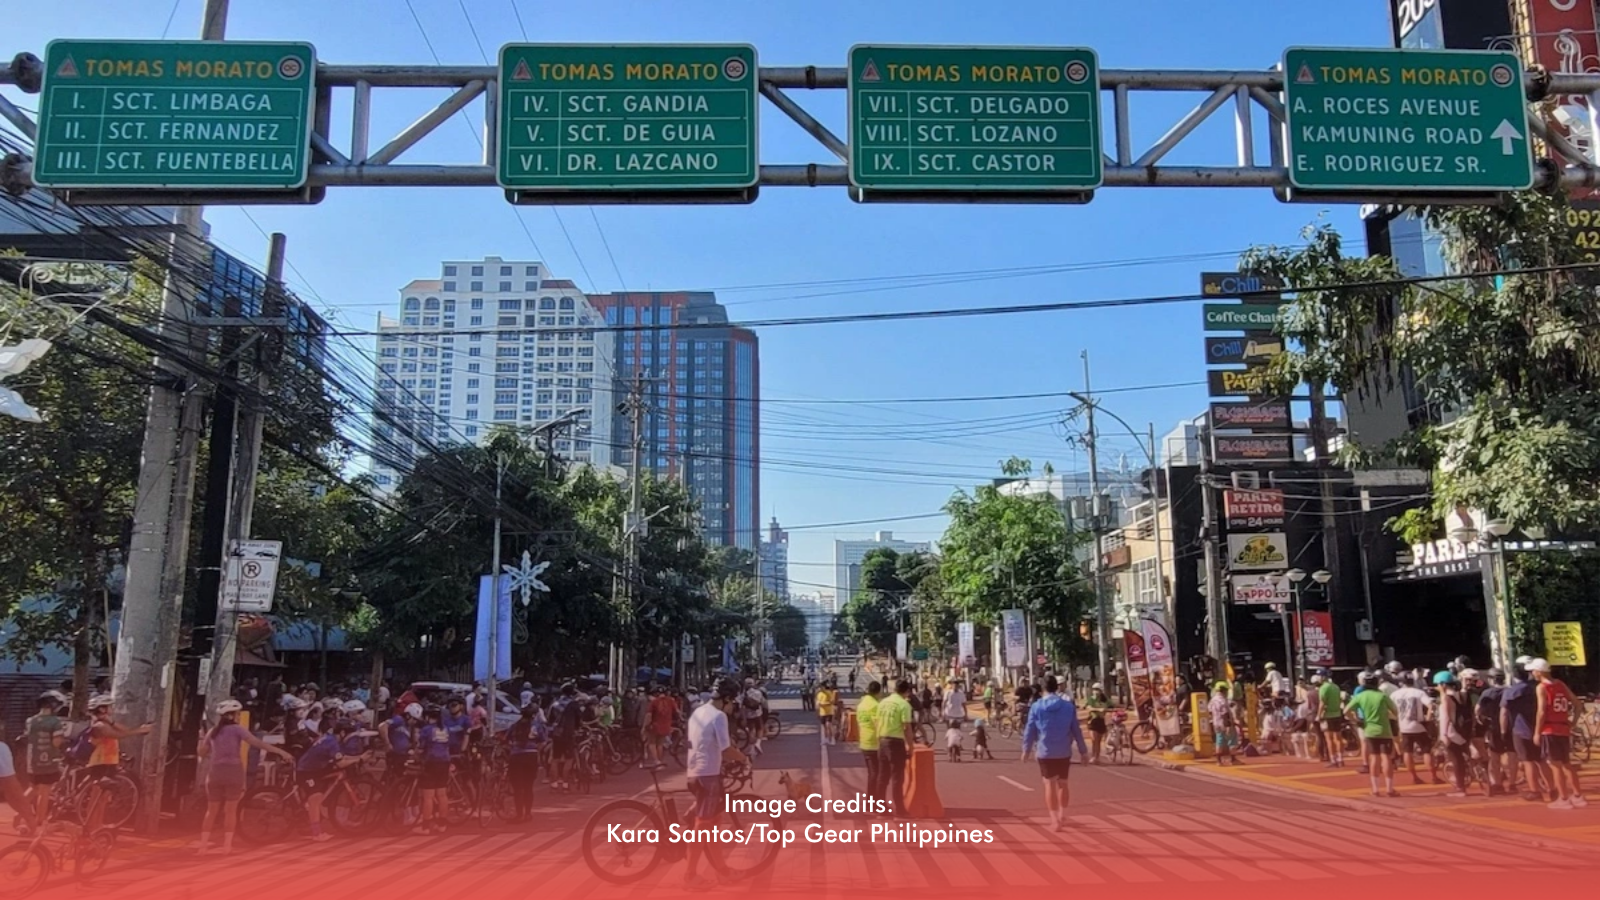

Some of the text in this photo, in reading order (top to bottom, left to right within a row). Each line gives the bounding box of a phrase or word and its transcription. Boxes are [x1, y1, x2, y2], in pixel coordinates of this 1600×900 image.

[85, 59, 273, 78] TOMAS MORATO
[539, 63, 718, 81] TOMAS MORATO
[886, 64, 1061, 82] TOMAS MORATO
[1320, 66, 1487, 85] TOMAS MORATO
[73, 92, 272, 111] I. SCT. LIMBAGA
[524, 95, 709, 112] IV. SCT. GANDIA
[868, 96, 1069, 114] VII. SCT. DELGADO
[1293, 97, 1480, 115] A. ROCES AVENUE
[65, 121, 279, 140] II. SCT. FERNANDEZ
[527, 124, 716, 141] V. SCT. DE GUIA
[866, 125, 1057, 142] VIII. SCT. LOZANO
[1303, 126, 1483, 144] KAMUNING ROAD
[57, 152, 294, 170] III. SCT. FUENTEBELLA
[520, 153, 718, 171] VI. DR. LAZCANO
[874, 153, 1055, 171] IX. SCT. CASTOR
[1297, 154, 1486, 173] E. RODRIGUEZ SR.
[1207, 311, 1247, 322] Coffee
[1230, 503, 1282, 514] RETIRO
[1248, 517, 1263, 527] 24
[1418, 567, 1437, 576] THE
[1445, 563, 1470, 573] BEST
